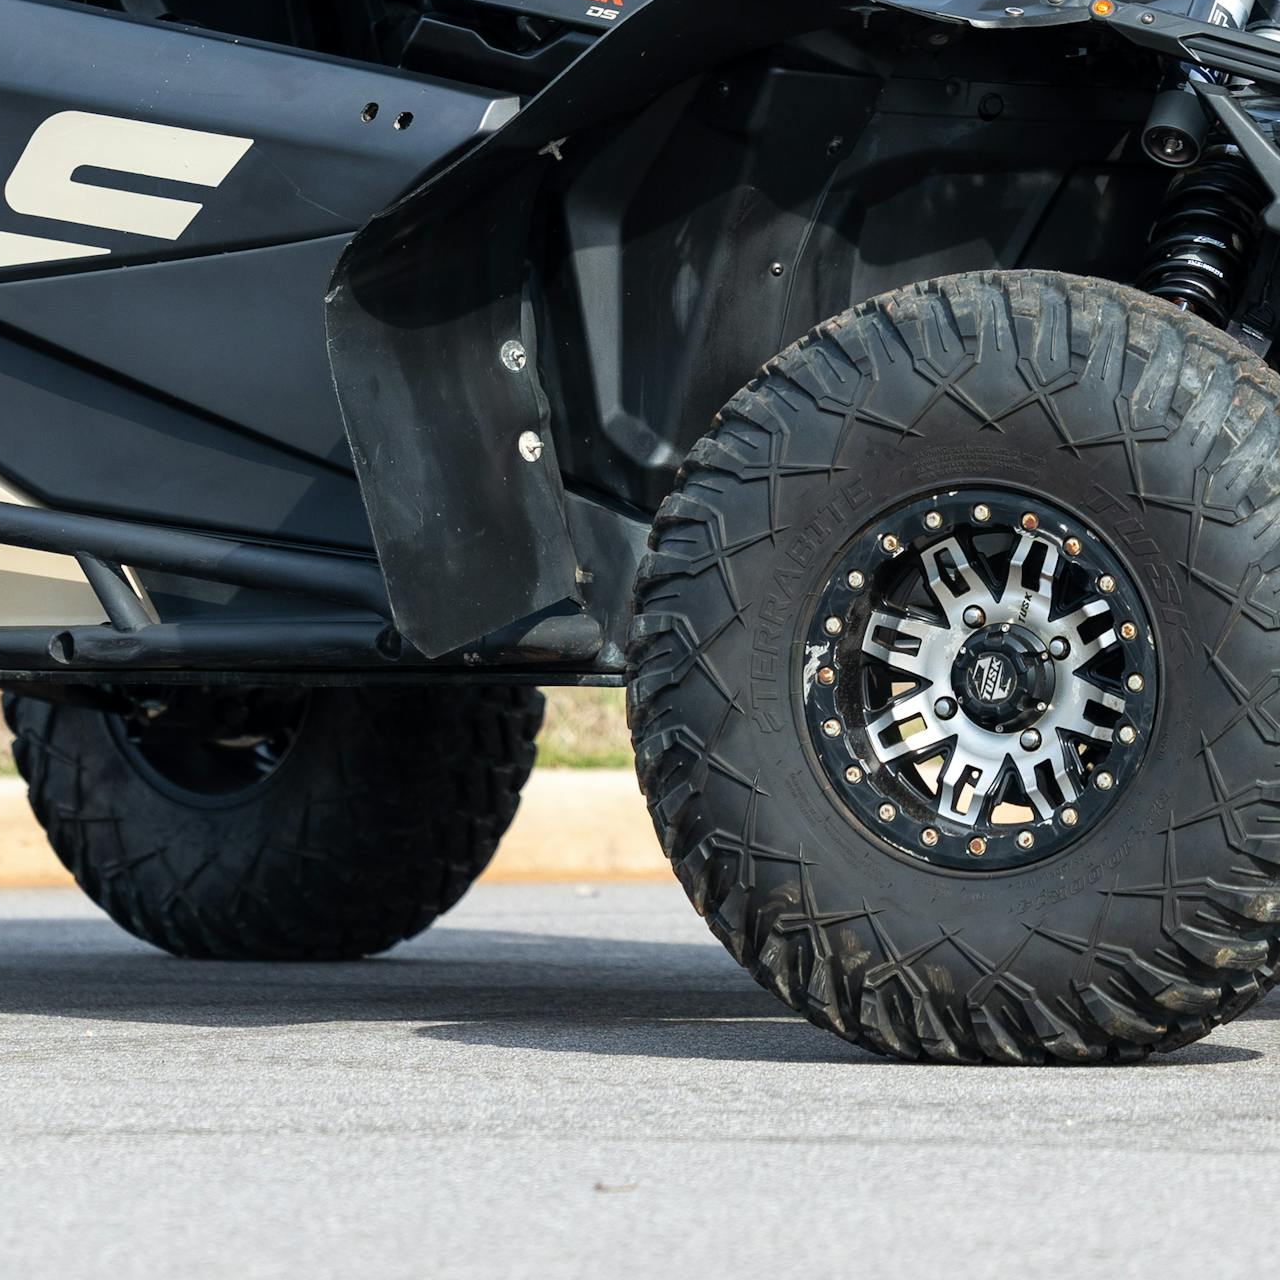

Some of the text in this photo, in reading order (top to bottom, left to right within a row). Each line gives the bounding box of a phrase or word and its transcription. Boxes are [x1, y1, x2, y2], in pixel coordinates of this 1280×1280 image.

[586, 5, 619, 20] DS
[1018, 591, 1033, 624] TUSK
[981, 655, 1003, 700] TUSK
